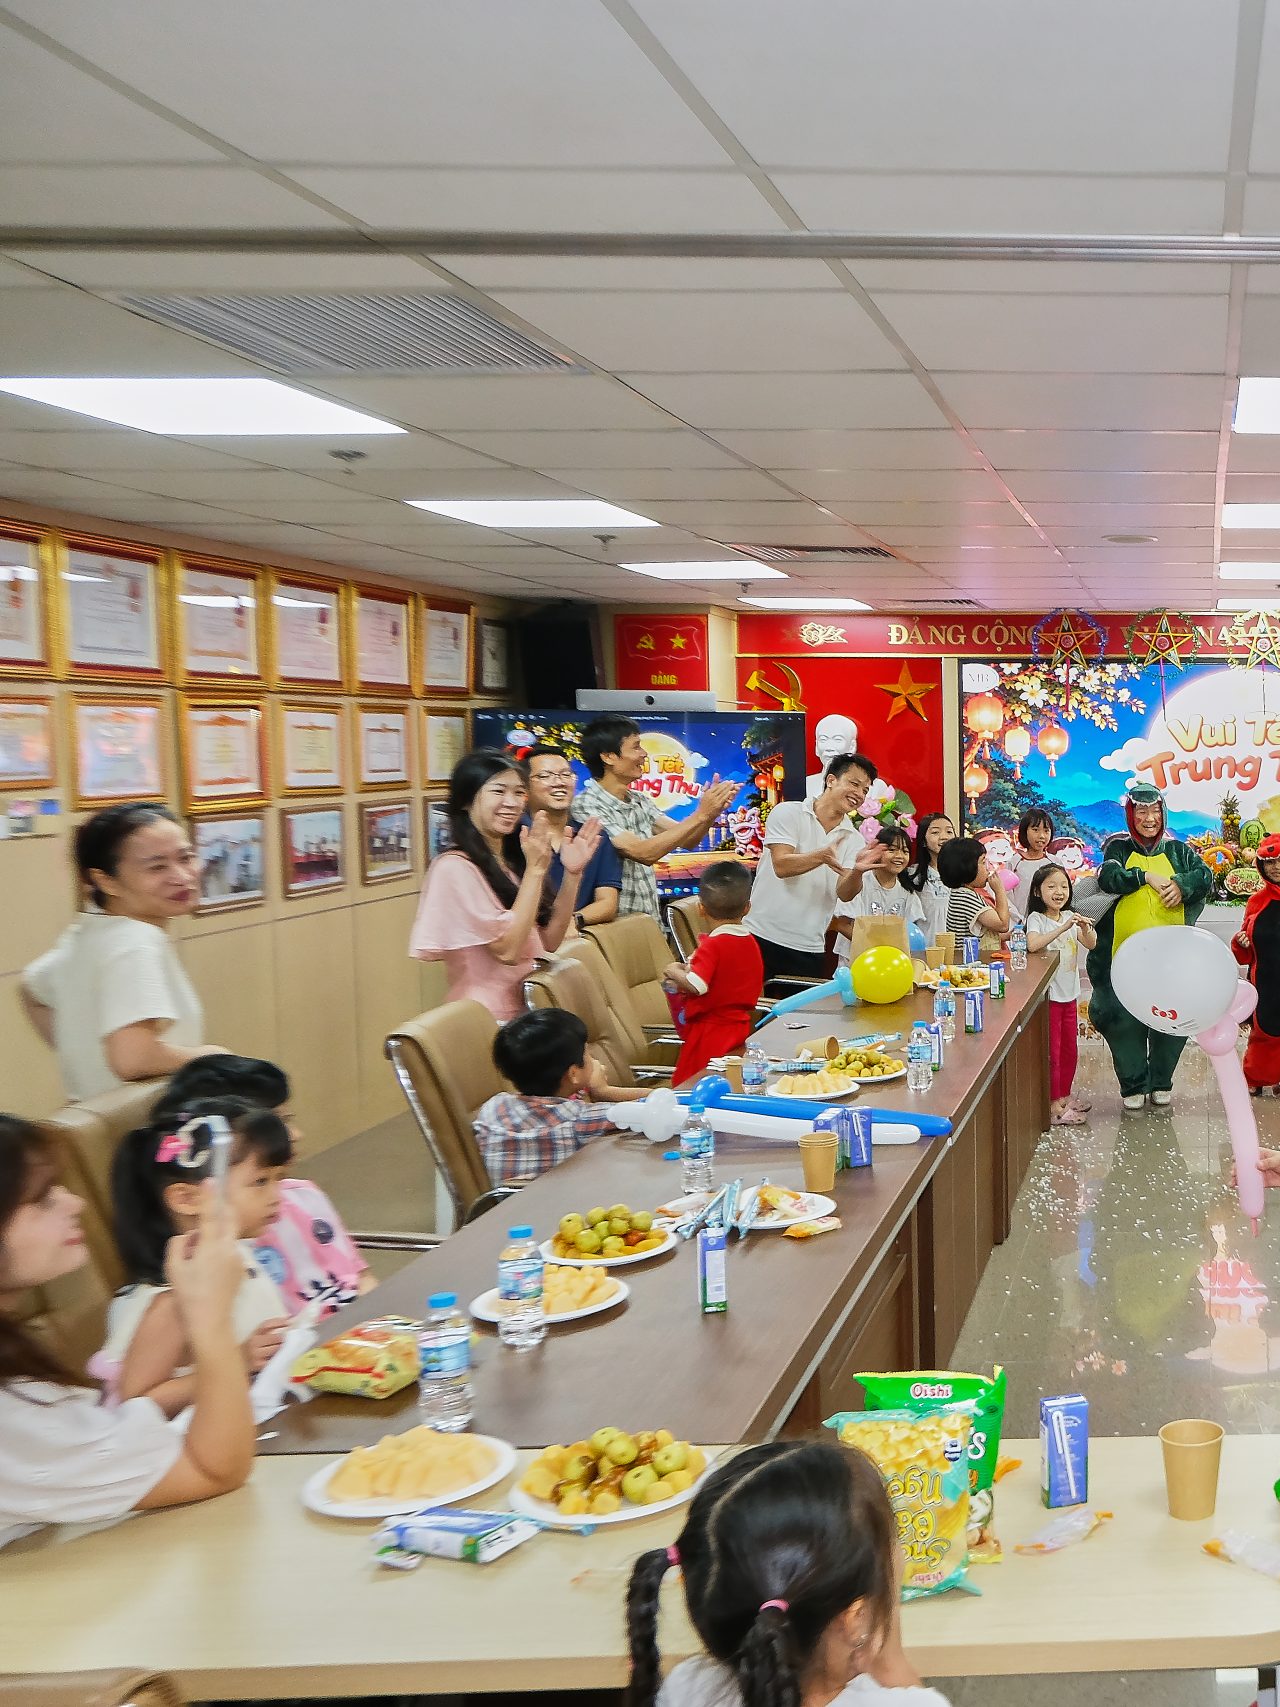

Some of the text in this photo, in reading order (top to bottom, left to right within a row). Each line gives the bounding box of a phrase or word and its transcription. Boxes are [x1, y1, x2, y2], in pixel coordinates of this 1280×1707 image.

[888, 616, 966, 645] ĐẢNG
[1166, 713, 1237, 752] Vui
[1135, 750, 1262, 791] Trung
[911, 1383, 951, 1398] Oishi
